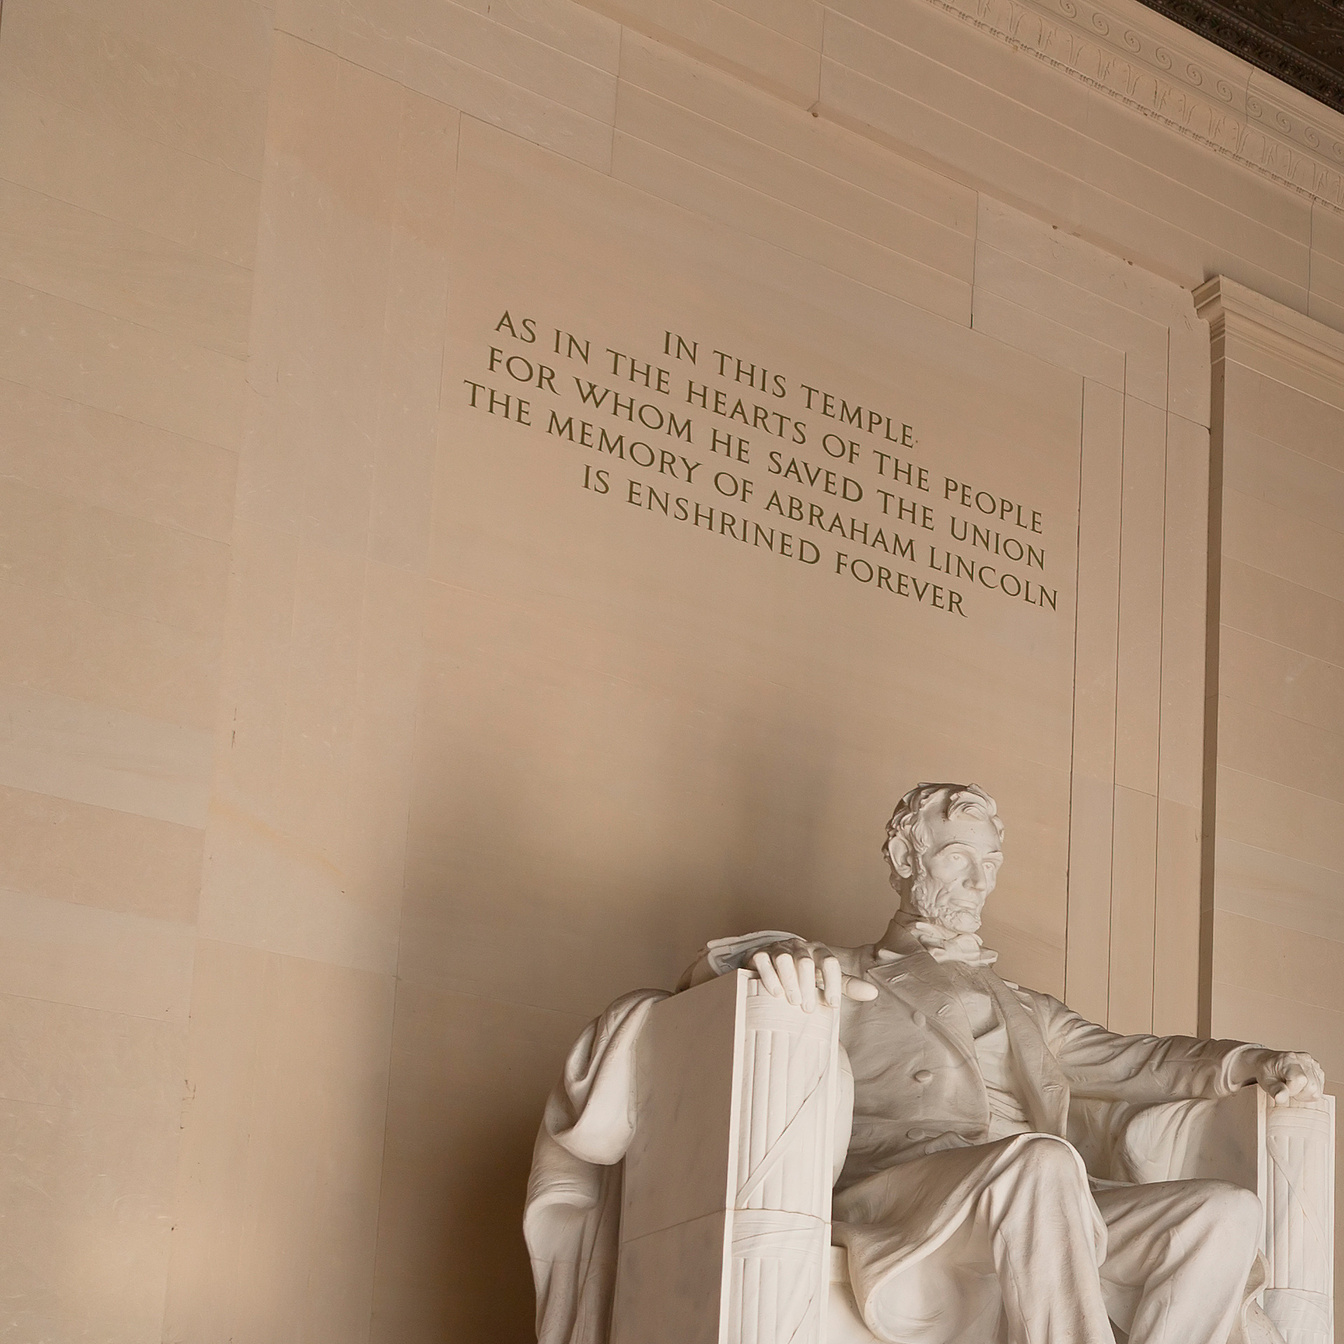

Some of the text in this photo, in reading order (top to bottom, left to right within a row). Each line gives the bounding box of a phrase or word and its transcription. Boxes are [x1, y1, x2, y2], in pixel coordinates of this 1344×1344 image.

[488, 346, 1044, 570] FOR WHOM HE SAVED THE UNION
[494, 310, 1042, 534] AS IN THE HEARTS OF THE PEOPLE
[664, 331, 697, 365] IN
[713, 350, 785, 398] THIS
[463, 379, 1057, 611] THE MEMORY OF ABRAHAM LINCOLN
[583, 464, 967, 617] IS ENSHRINED FOREVER
